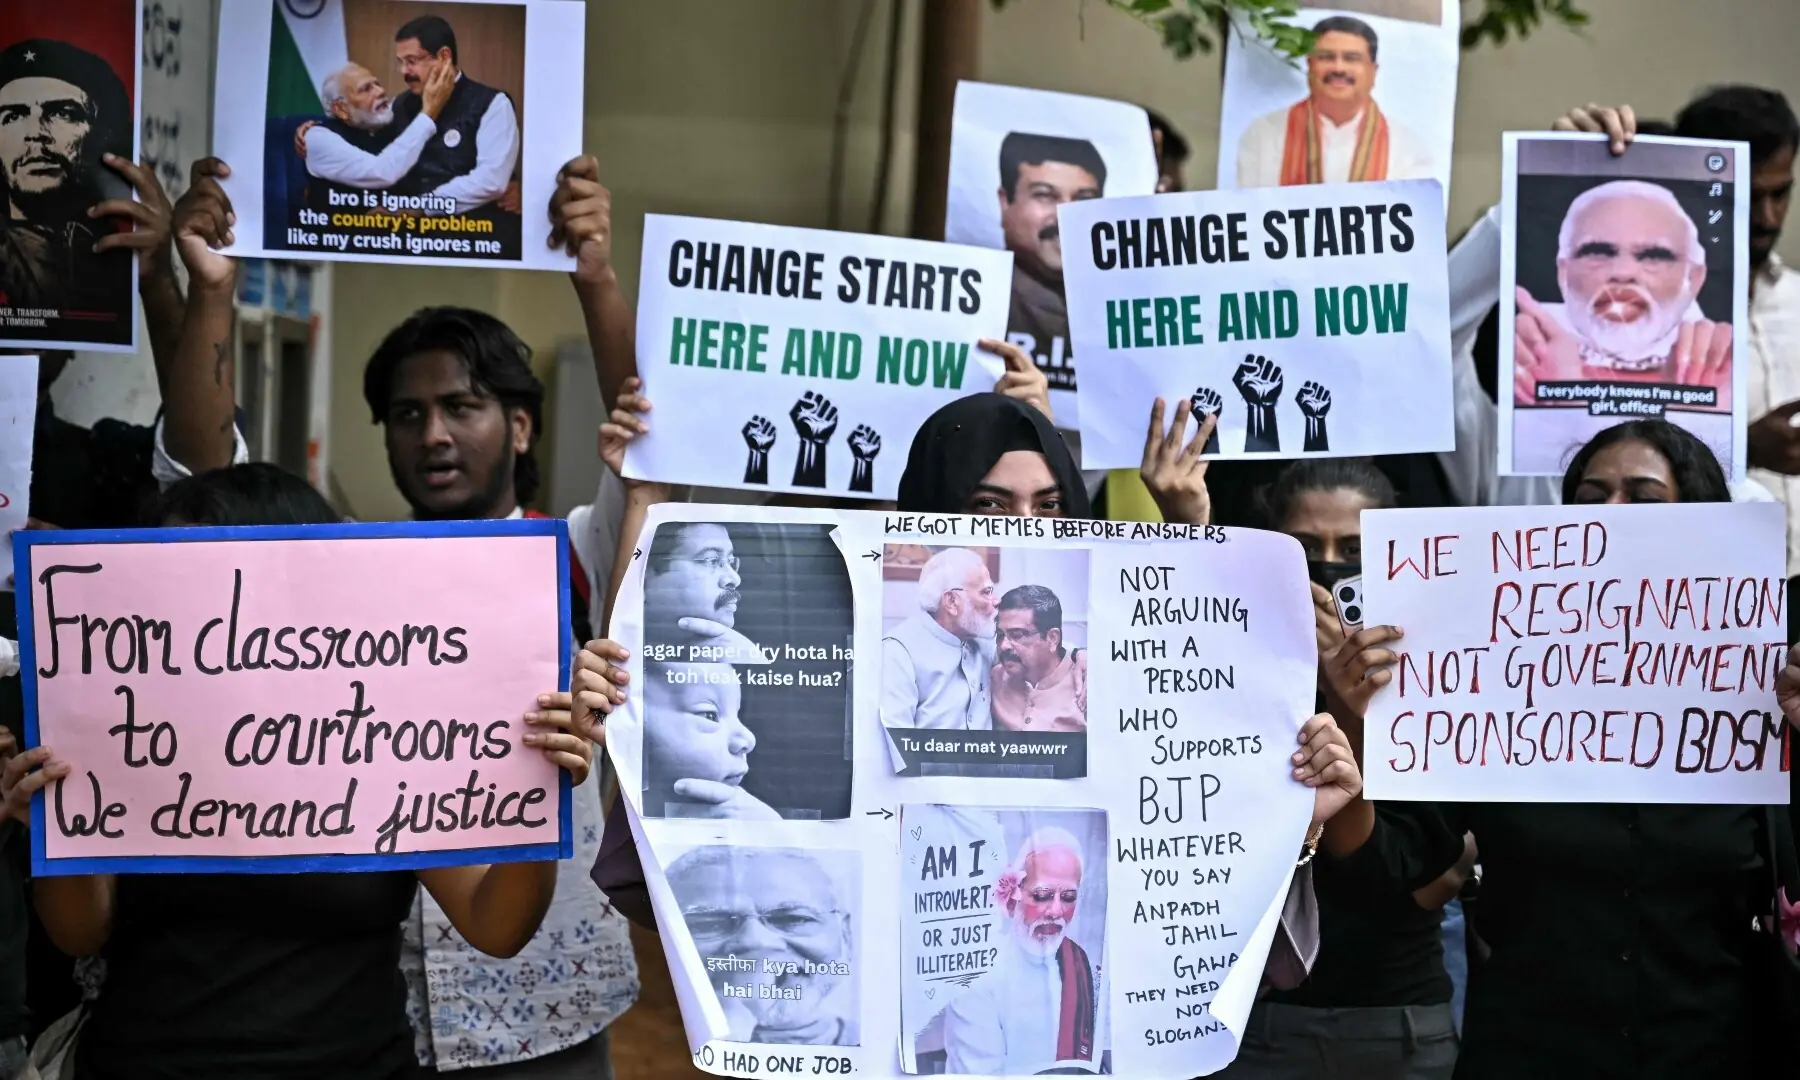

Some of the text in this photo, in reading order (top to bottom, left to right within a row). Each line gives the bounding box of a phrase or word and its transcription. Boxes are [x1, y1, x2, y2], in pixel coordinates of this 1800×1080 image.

[329, 188, 456, 214] bro is ignoring
[299, 208, 493, 233] the country's problem
[287, 228, 502, 254] like my crush ignores me
[1091, 202, 1415, 271] CHANGE STARTS
[668, 239, 983, 315] CHANGE STARTS
[6, 317, 47, 327] TOMORROW.
[1105, 282, 1408, 350] HERE AND NOW
[669, 316, 970, 390] HERE AND NOW
[1538, 385, 1714, 404] Everybody knows I'm a good
[1591, 401, 1662, 414] girl, officer
[885, 516, 912, 534] WE
[918, 517, 961, 535] GOT
[970, 517, 1044, 537] MEMES
[1131, 522, 1226, 543] ANSWERS
[1387, 521, 1607, 581] WE NEED
[1121, 565, 1176, 593] NOT
[39, 563, 469, 679] From classrooms
[1131, 596, 1248, 632] ARGUING
[1490, 576, 1786, 654] RESIGNATION
[643, 644, 684, 661] agar
[689, 644, 743, 662] paper
[749, 643, 780, 663] dry
[785, 644, 827, 660] hota
[1112, 636, 1199, 662] WITH A
[666, 668, 842, 687] toh leak kaise hua?
[1144, 665, 1234, 694] PERSON
[1399, 641, 1788, 708] NOT GOVERNMENT
[108, 681, 512, 768] to courtrooms
[1120, 707, 1177, 733] WHO
[901, 737, 1068, 757] Tu daar mat yaawwrr
[1151, 734, 1262, 765] SUPPORTS
[1389, 707, 1790, 773] SPONSORED BDSM
[53, 769, 547, 854] We demand justice
[1140, 774, 1221, 825] BJP
[921, 839, 986, 881] AM I
[1117, 831, 1245, 863] WHATEVER
[1141, 867, 1231, 891] YOU SAY
[1133, 900, 1220, 924] ANPADH
[923, 923, 992, 947] OR JUST
[1162, 923, 1238, 946] JAHIL
[707, 954, 850, 976] इस्तीफा kya hota
[916, 948, 998, 975] ILLITERATE?
[723, 982, 801, 1000] hai bhai
[1125, 980, 1219, 1004] THEY NEED
[1176, 1001, 1212, 1019] NOT
[724, 1051, 759, 1073] HAD
[766, 1056, 804, 1073] ONE
[812, 1056, 858, 1074] JOB.
